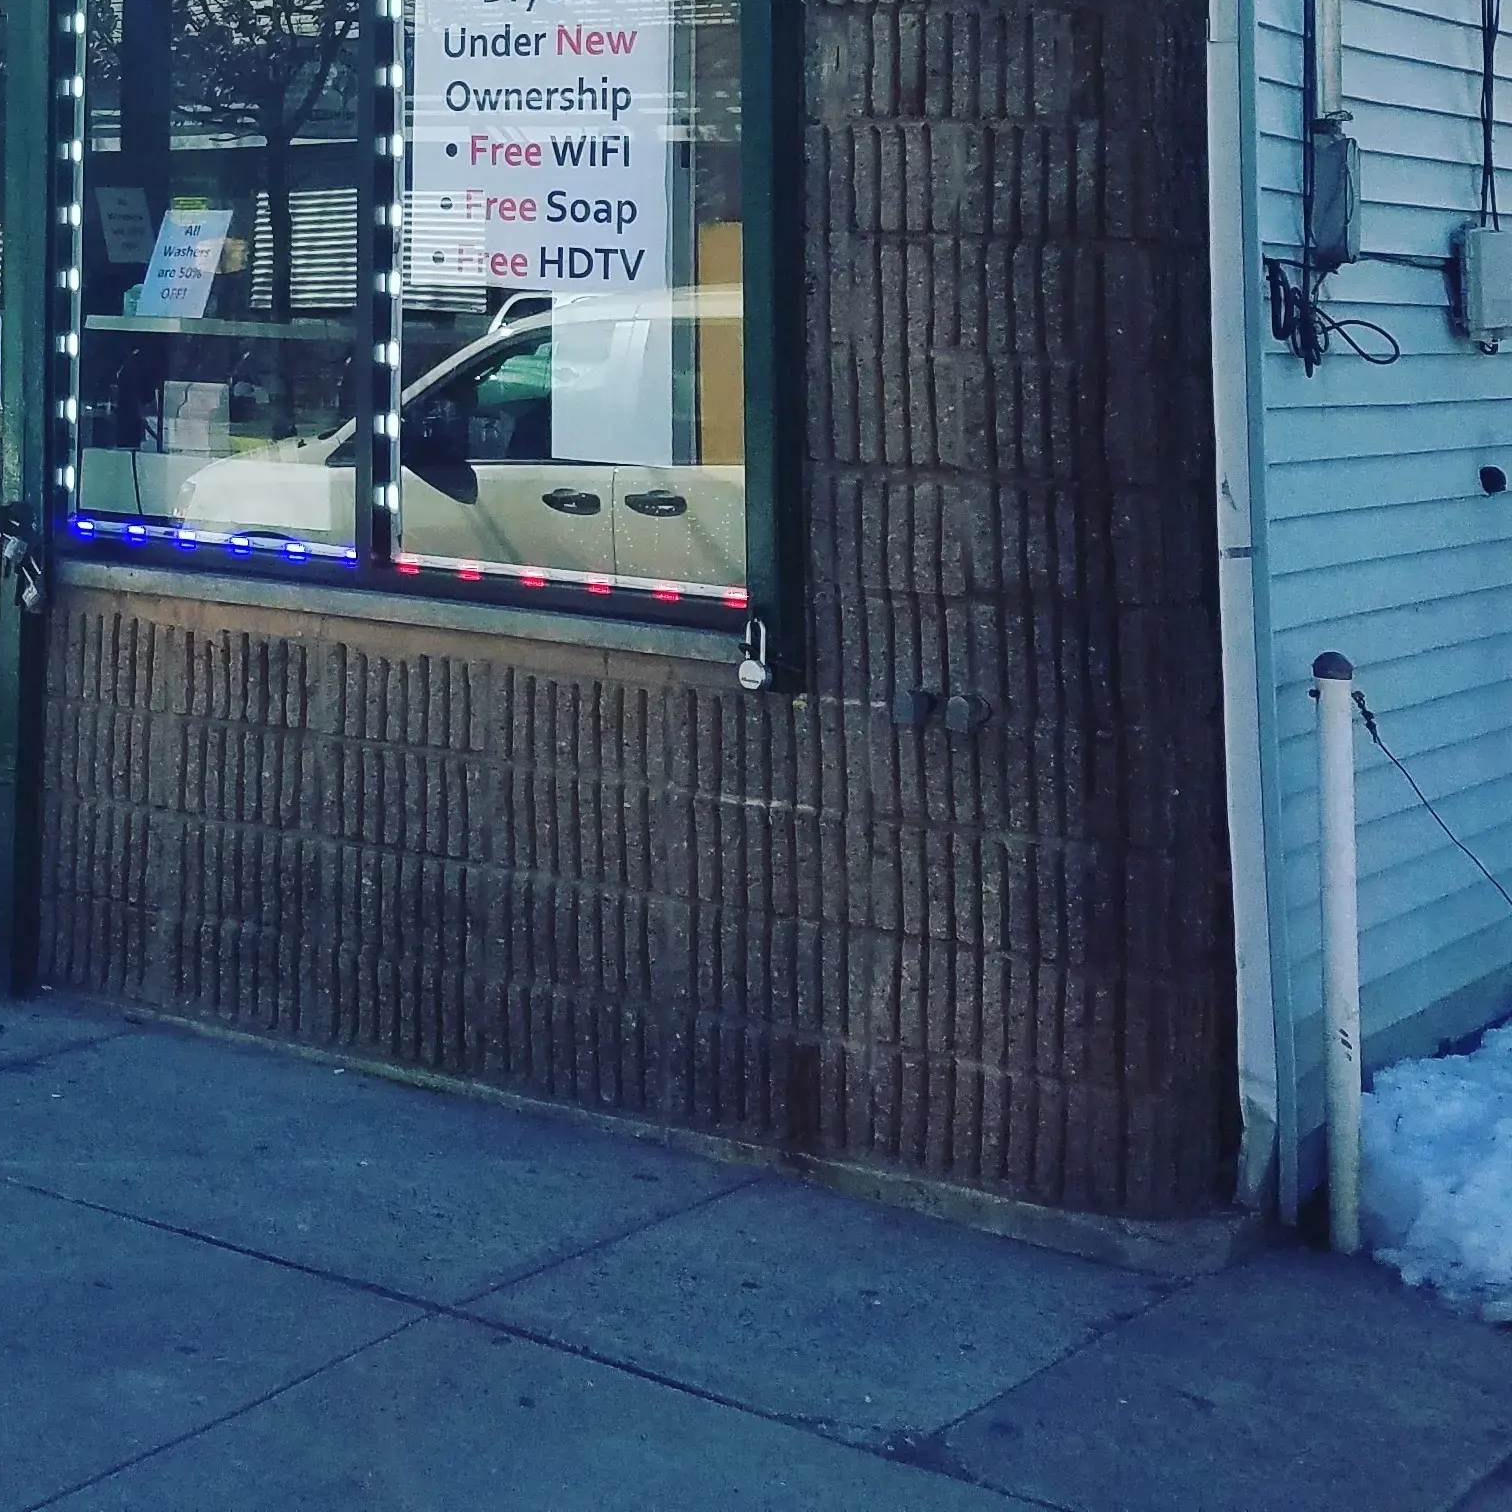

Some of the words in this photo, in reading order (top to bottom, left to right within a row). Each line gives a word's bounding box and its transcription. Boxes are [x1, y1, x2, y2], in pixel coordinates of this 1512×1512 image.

[444, 24, 547, 58] Under
[556, 24, 638, 56] New
[445, 76, 633, 122] Ownership
[470, 135, 542, 167] Free
[549, 135, 630, 168] WIFI
[465, 189, 537, 222] Free
[546, 190, 638, 235] Soap
[184, 224, 202, 237] All
[162, 245, 212, 258] Washers
[457, 244, 529, 277] Free
[539, 246, 646, 281] HDTV
[157, 268, 176, 279] are
[161, 287, 188, 300] OFF!
